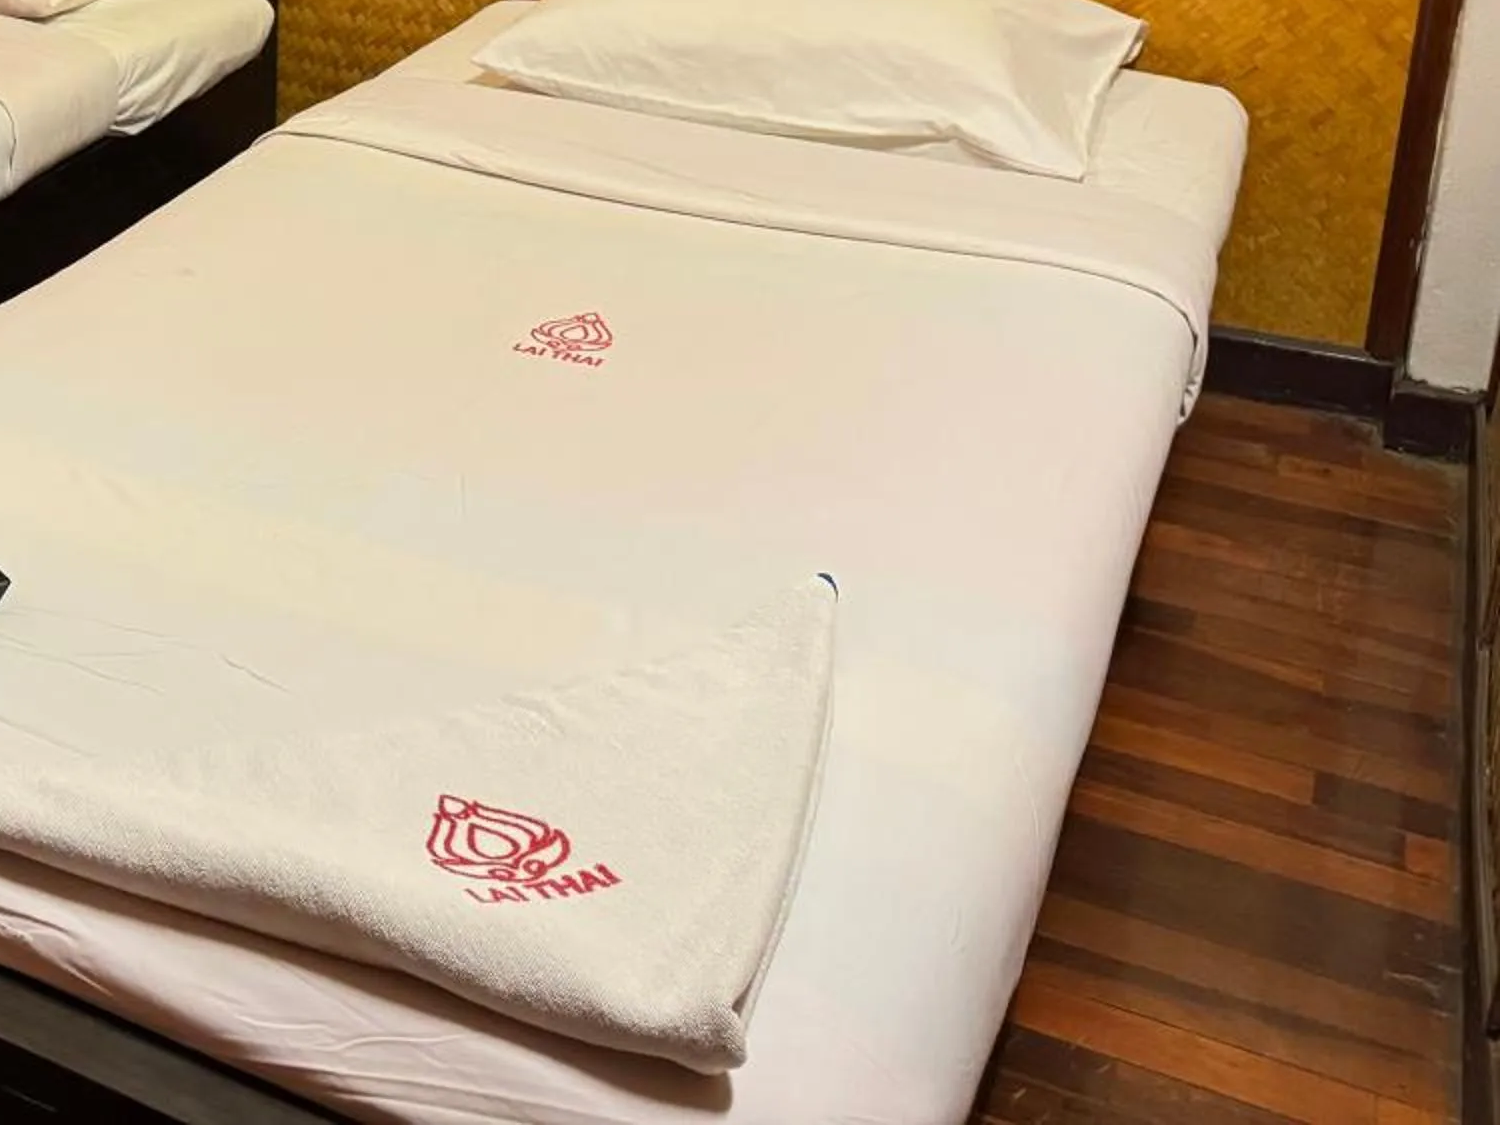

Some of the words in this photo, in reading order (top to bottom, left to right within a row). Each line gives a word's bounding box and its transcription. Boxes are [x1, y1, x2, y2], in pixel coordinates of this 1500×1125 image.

[512, 343, 546, 356] LAI
[552, 349, 604, 367] THAI
[464, 886, 531, 904] LAI
[523, 863, 622, 900] THAI
